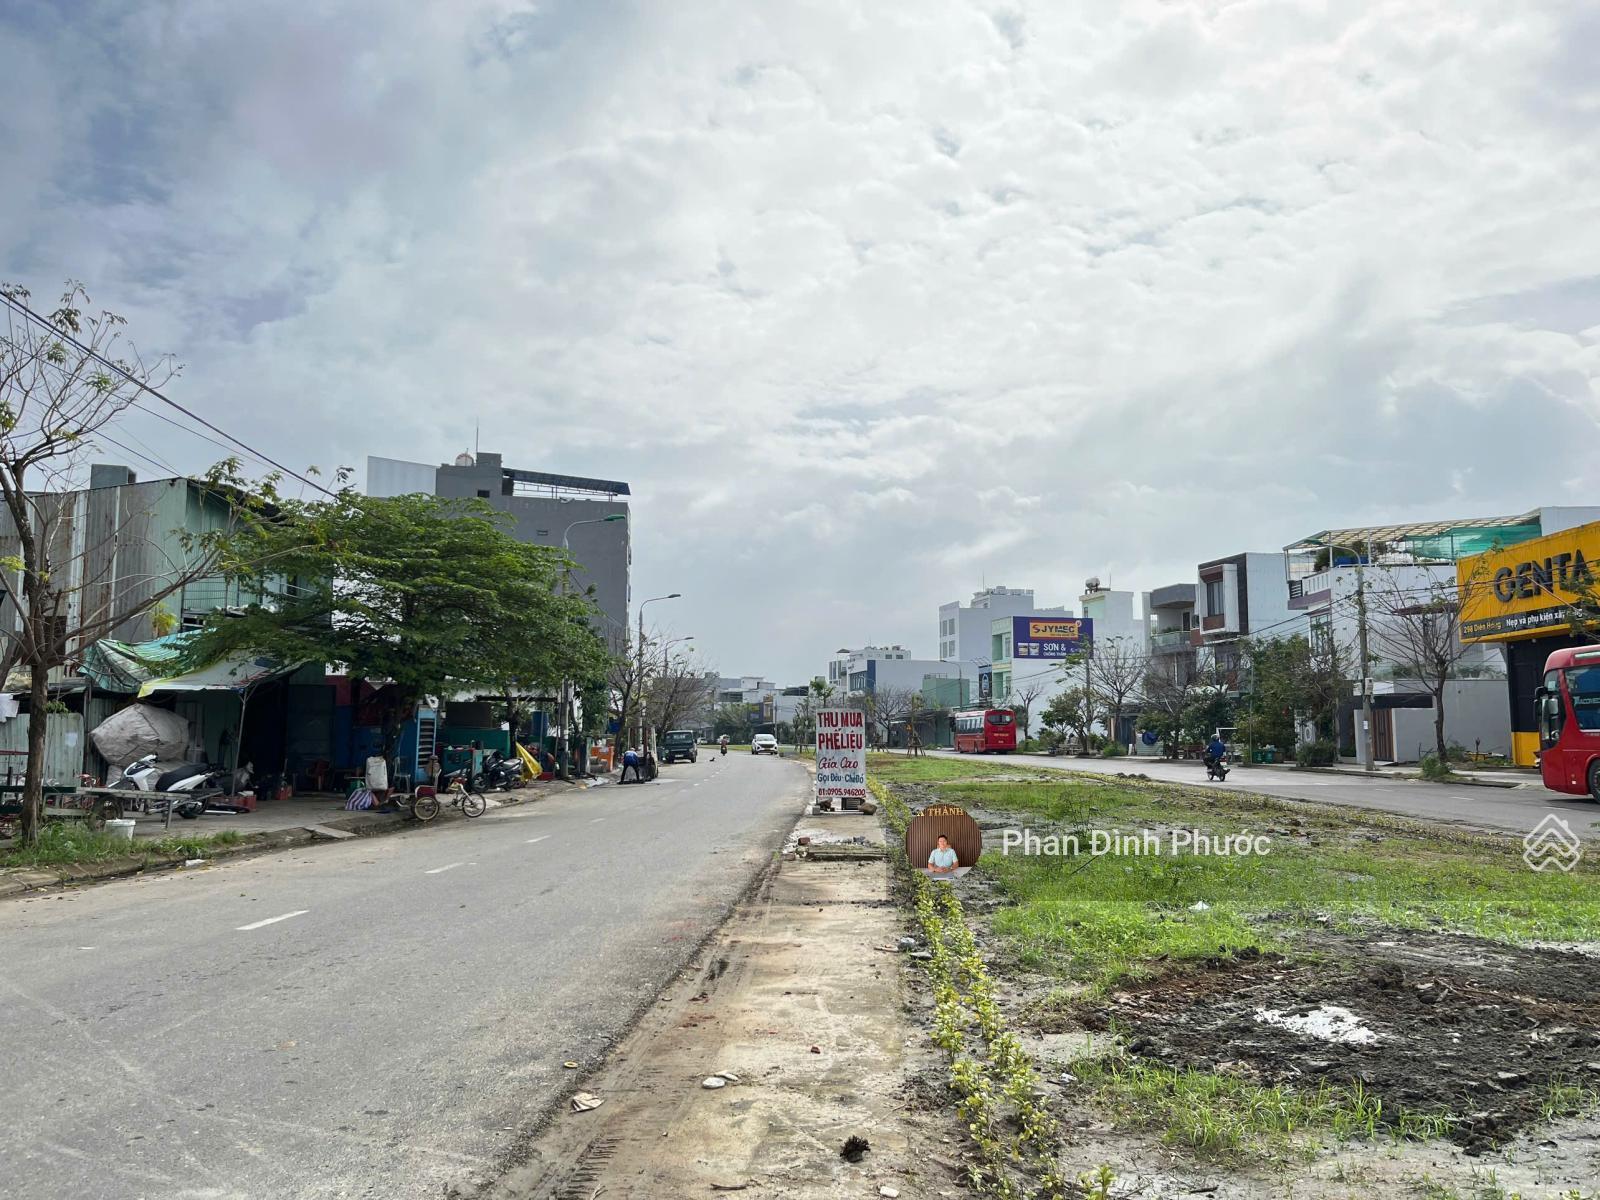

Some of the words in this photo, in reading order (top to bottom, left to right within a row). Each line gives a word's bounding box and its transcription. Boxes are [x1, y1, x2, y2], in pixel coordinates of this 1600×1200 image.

[1494, 548, 1595, 603] GENTA
[1506, 618, 1518, 629] Nẹp
[1518, 616, 1527, 625] và
[1527, 613, 1540, 625] phụ
[1539, 611, 1554, 623] kiện
[1043, 642, 1059, 651] SƠN
[1060, 643, 1066, 651] &
[817, 711, 839, 728] THU
[840, 711, 863, 728] MUA
[818, 756, 837, 770] Giá
[840, 756, 859, 769] Cao
[817, 772, 830, 784] Gọi
